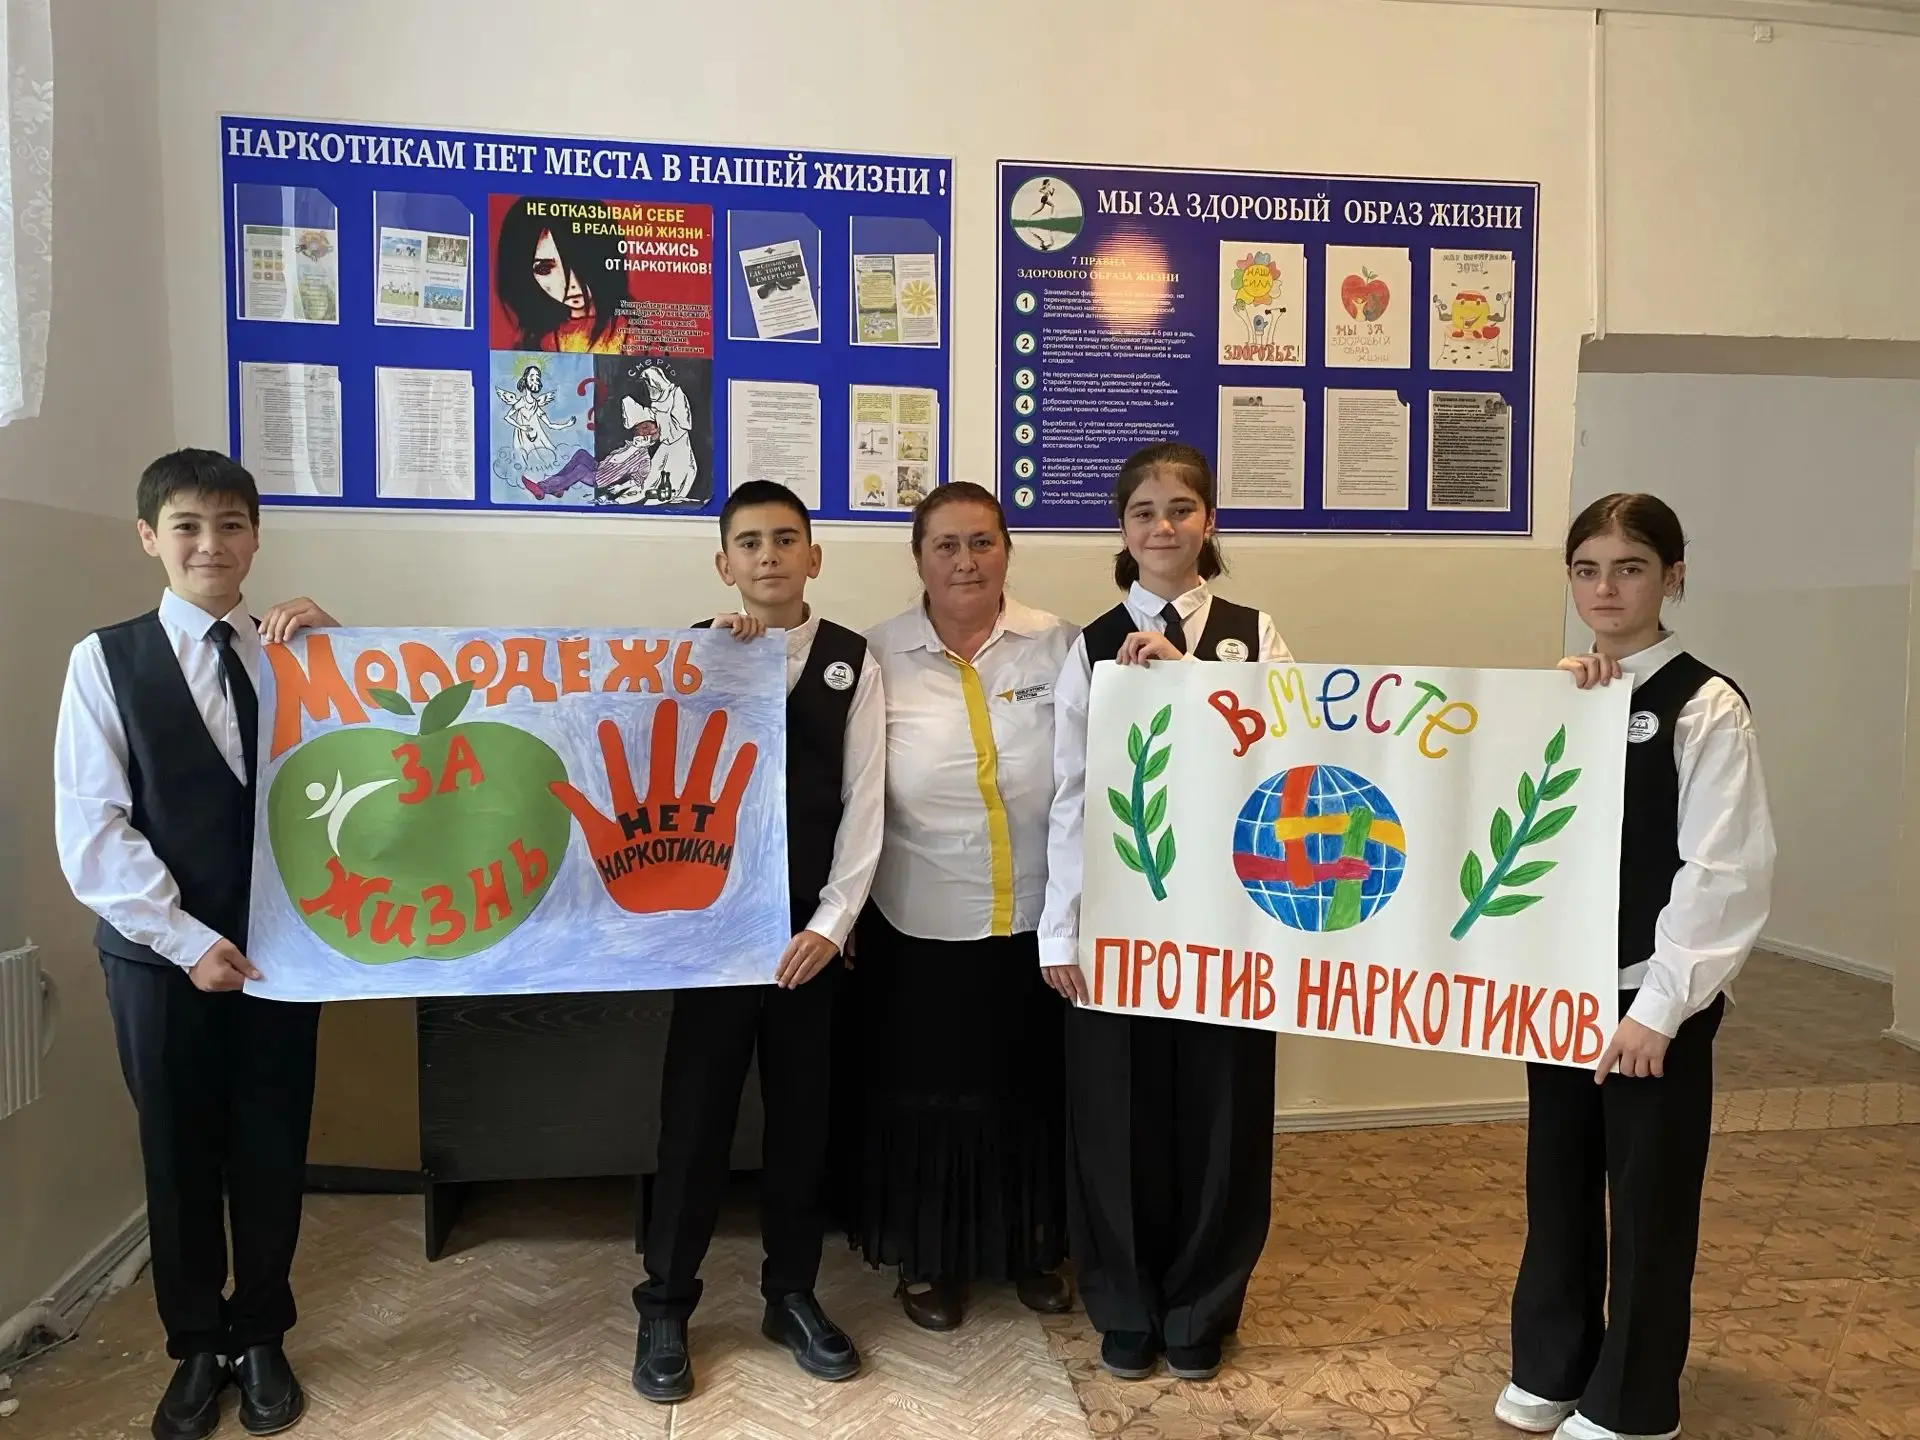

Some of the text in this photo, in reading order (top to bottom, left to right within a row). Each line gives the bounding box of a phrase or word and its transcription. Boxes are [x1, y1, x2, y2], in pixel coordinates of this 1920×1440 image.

[228, 126, 466, 170] НАРКОТИКАМ
[473, 142, 538, 174] НЕТ
[543, 147, 653, 180] МЕСТА
[662, 154, 682, 183] В
[689, 153, 807, 188] НАШЕЙ
[814, 163, 931, 195] ЖИЗНИ
[527, 202, 685, 223] НЕ ОТКАЗЫВАЙ СЕБЕ
[1097, 189, 1523, 229] МЫ ЗА ЗДОРОВЫЙ ОБРАЗ ЖИЗНИ
[572, 222, 703, 240] В РЕАЛЬНОЙ ЖИЗНИ
[617, 240, 699, 257] ОТКАЖИСЬ
[605, 258, 712, 275] ОТ НАРКОТИКОВ!
[1071, 256, 1077, 265] 7
[1017, 268, 1180, 284] ЗДОРОВОГО ОБРАЗА ЖИЗНИ
[1243, 279, 1272, 289] СИЛА
[1043, 288, 1080, 296] Заниматься
[1022, 297, 1029, 309] 1
[1335, 323, 1384, 336] МЫ ЗА
[1021, 338, 1030, 350] 2
[1223, 344, 1300, 362] ЗДОРОВЬЕ!
[1021, 373, 1029, 385] 3
[1021, 399, 1030, 411] 4
[1021, 428, 1029, 441] 5
[1021, 462, 1029, 474] 6
[1020, 492, 1029, 504] 7
[390, 734, 486, 804] ЗА
[614, 803, 717, 841] НЕТ
[597, 836, 734, 884] НАРКОТИКАМ
[299, 837, 550, 949] ЖИЗНЬ
[1093, 936, 1276, 1020] ПРОТИВ
[1297, 956, 1605, 1064] НАРКОТИКОВ
